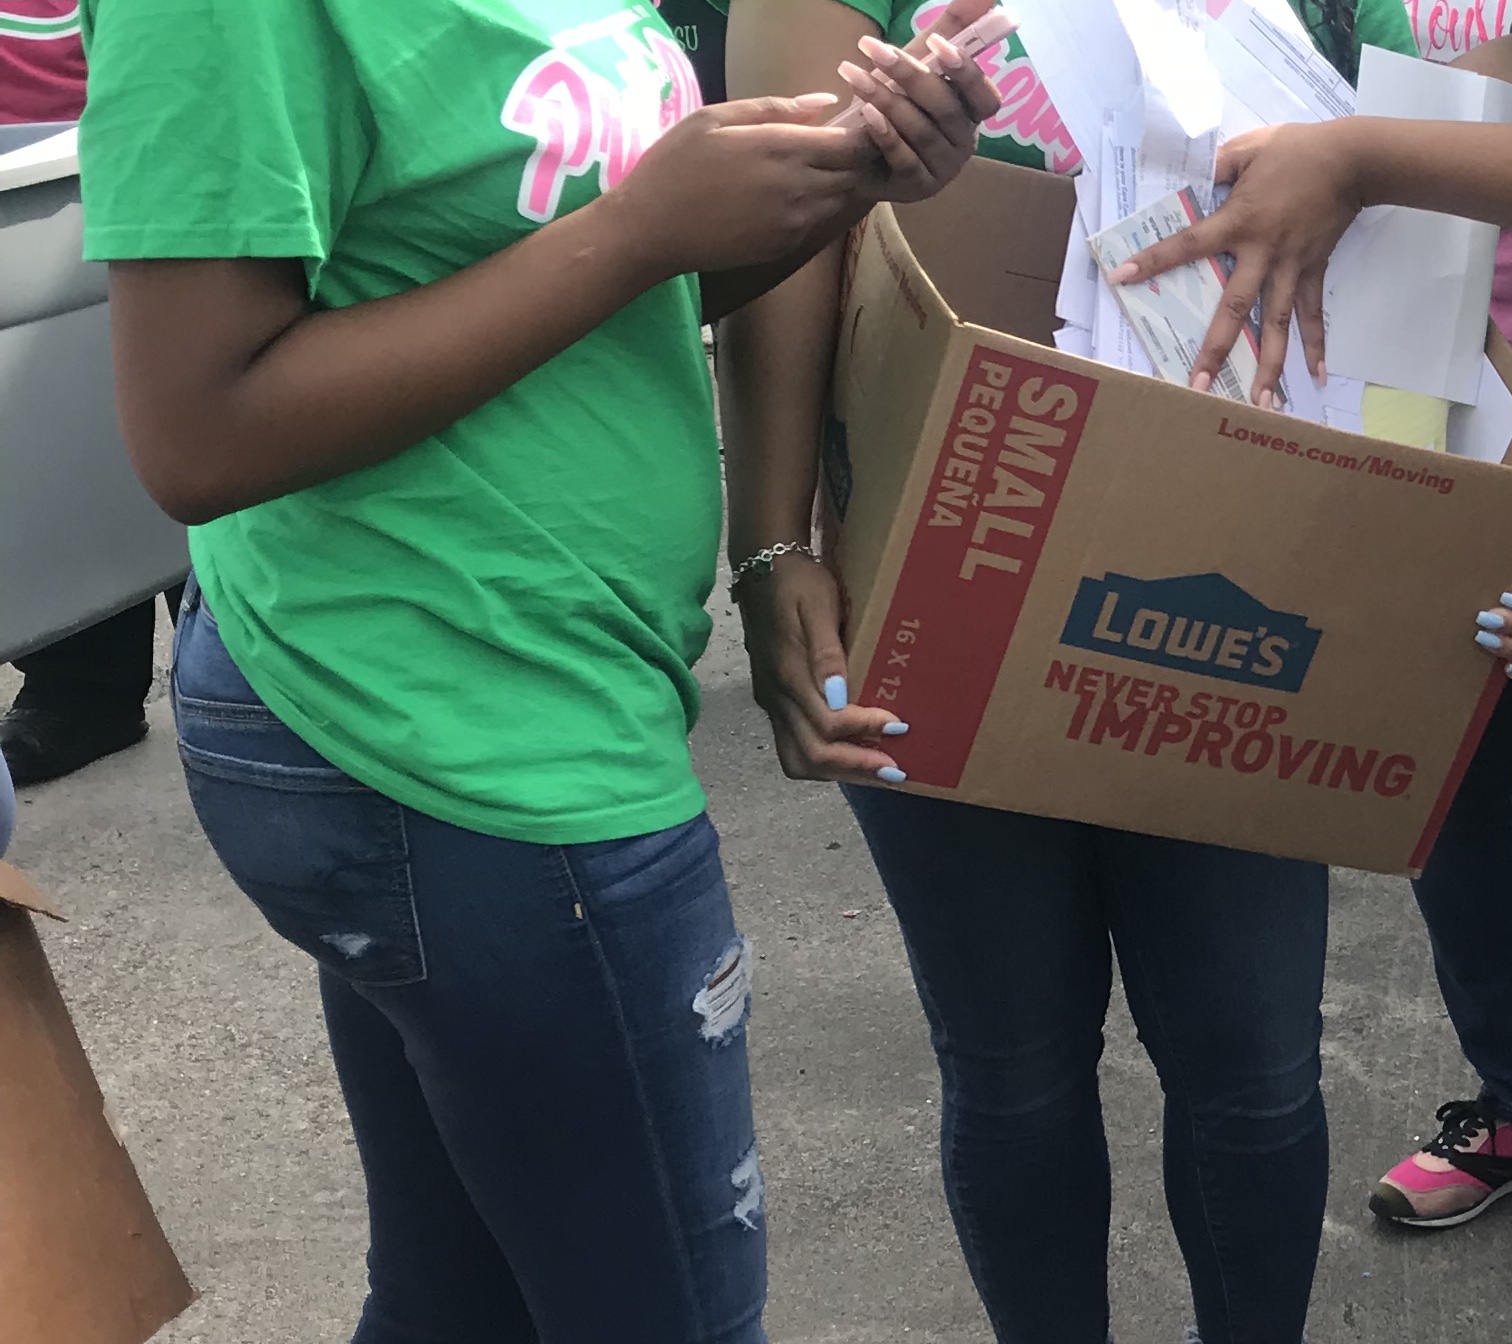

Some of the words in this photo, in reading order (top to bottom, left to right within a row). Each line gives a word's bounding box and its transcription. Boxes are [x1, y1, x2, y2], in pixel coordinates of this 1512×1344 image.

[926, 359, 1014, 529] PEQUEÑA
[957, 374, 1080, 583] SMALL
[1217, 416, 1457, 497] Lowes.com/Moving
[895, 618, 921, 645] 16
[1091, 590, 1297, 678] LOWE'S
[1043, 659, 1182, 717] NEVER
[1187, 691, 1289, 730] STOP
[1065, 694, 1418, 800] IMPROVING
